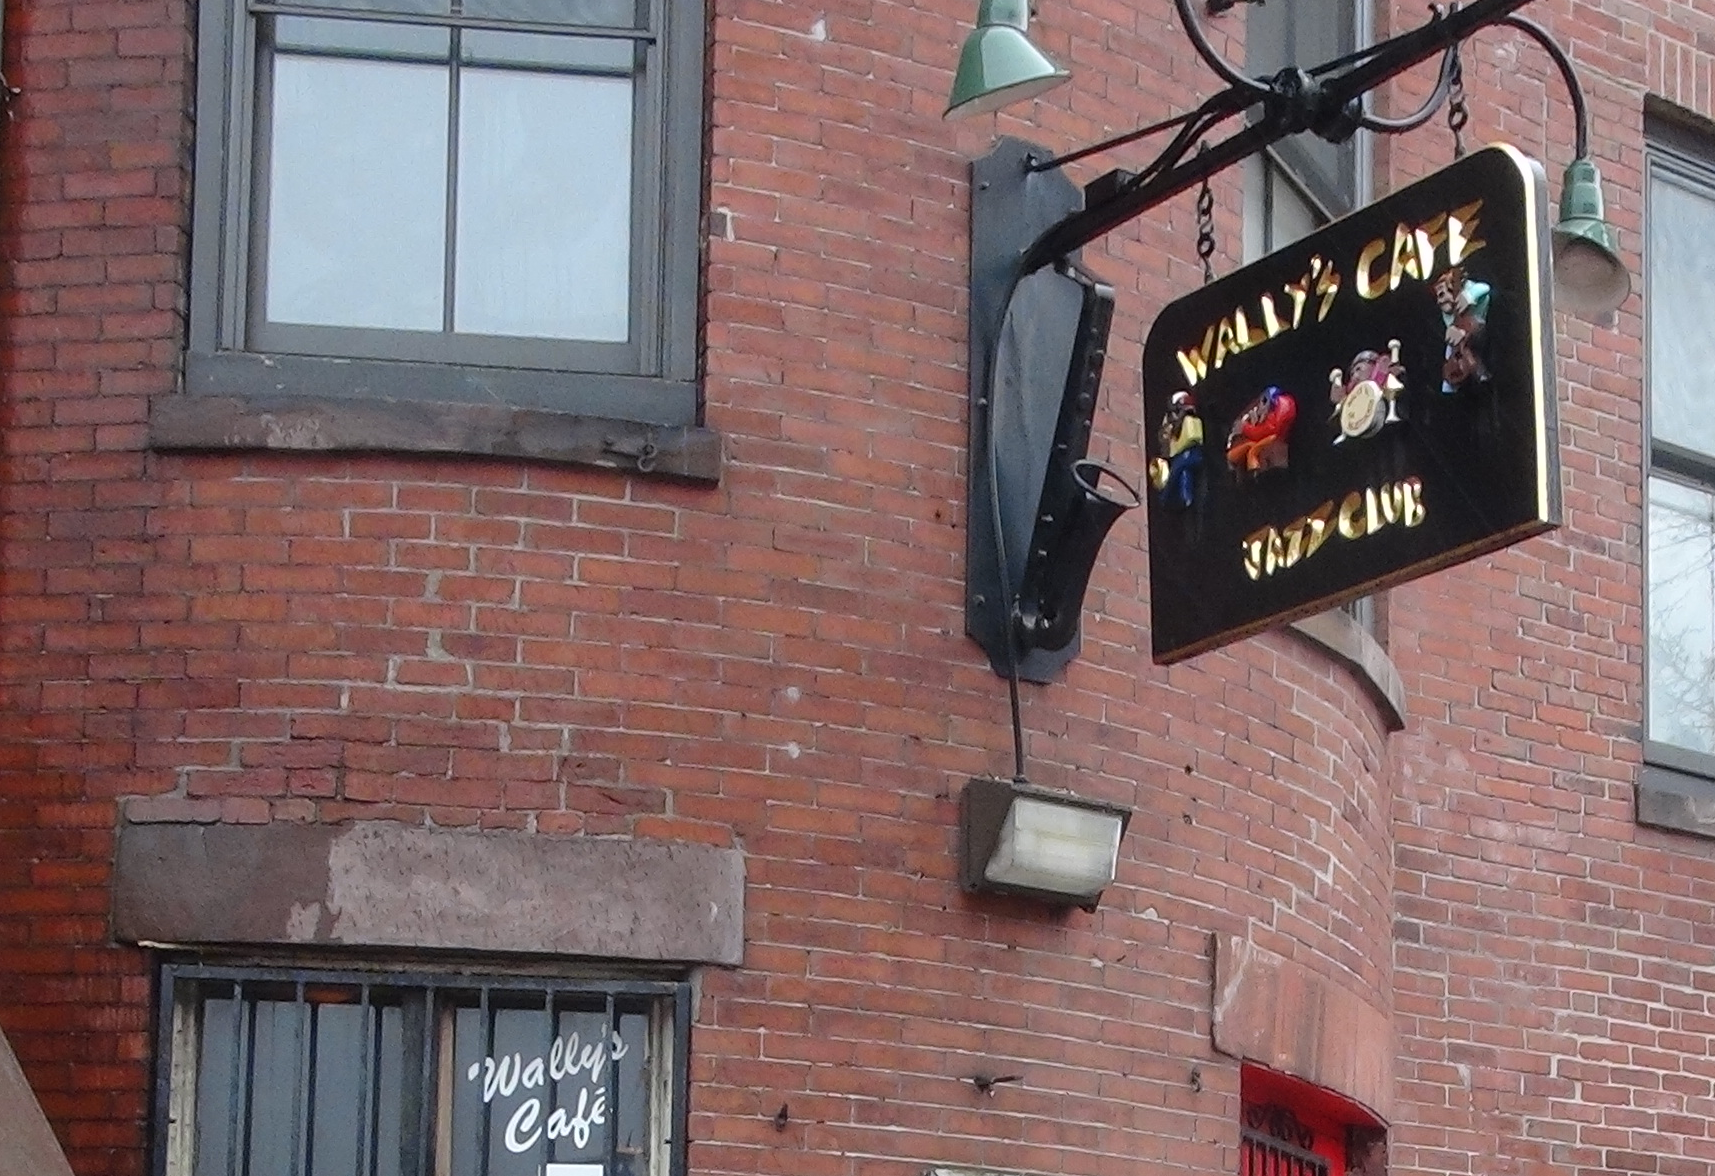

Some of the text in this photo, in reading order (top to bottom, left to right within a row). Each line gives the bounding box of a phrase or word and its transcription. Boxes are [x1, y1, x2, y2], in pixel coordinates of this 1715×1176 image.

[1356, 199, 1487, 299] CAFE
[1242, 475, 1427, 581] JAZZ CLUB
[468, 1021, 629, 1103] Wally's
[505, 1086, 613, 1153] Café
